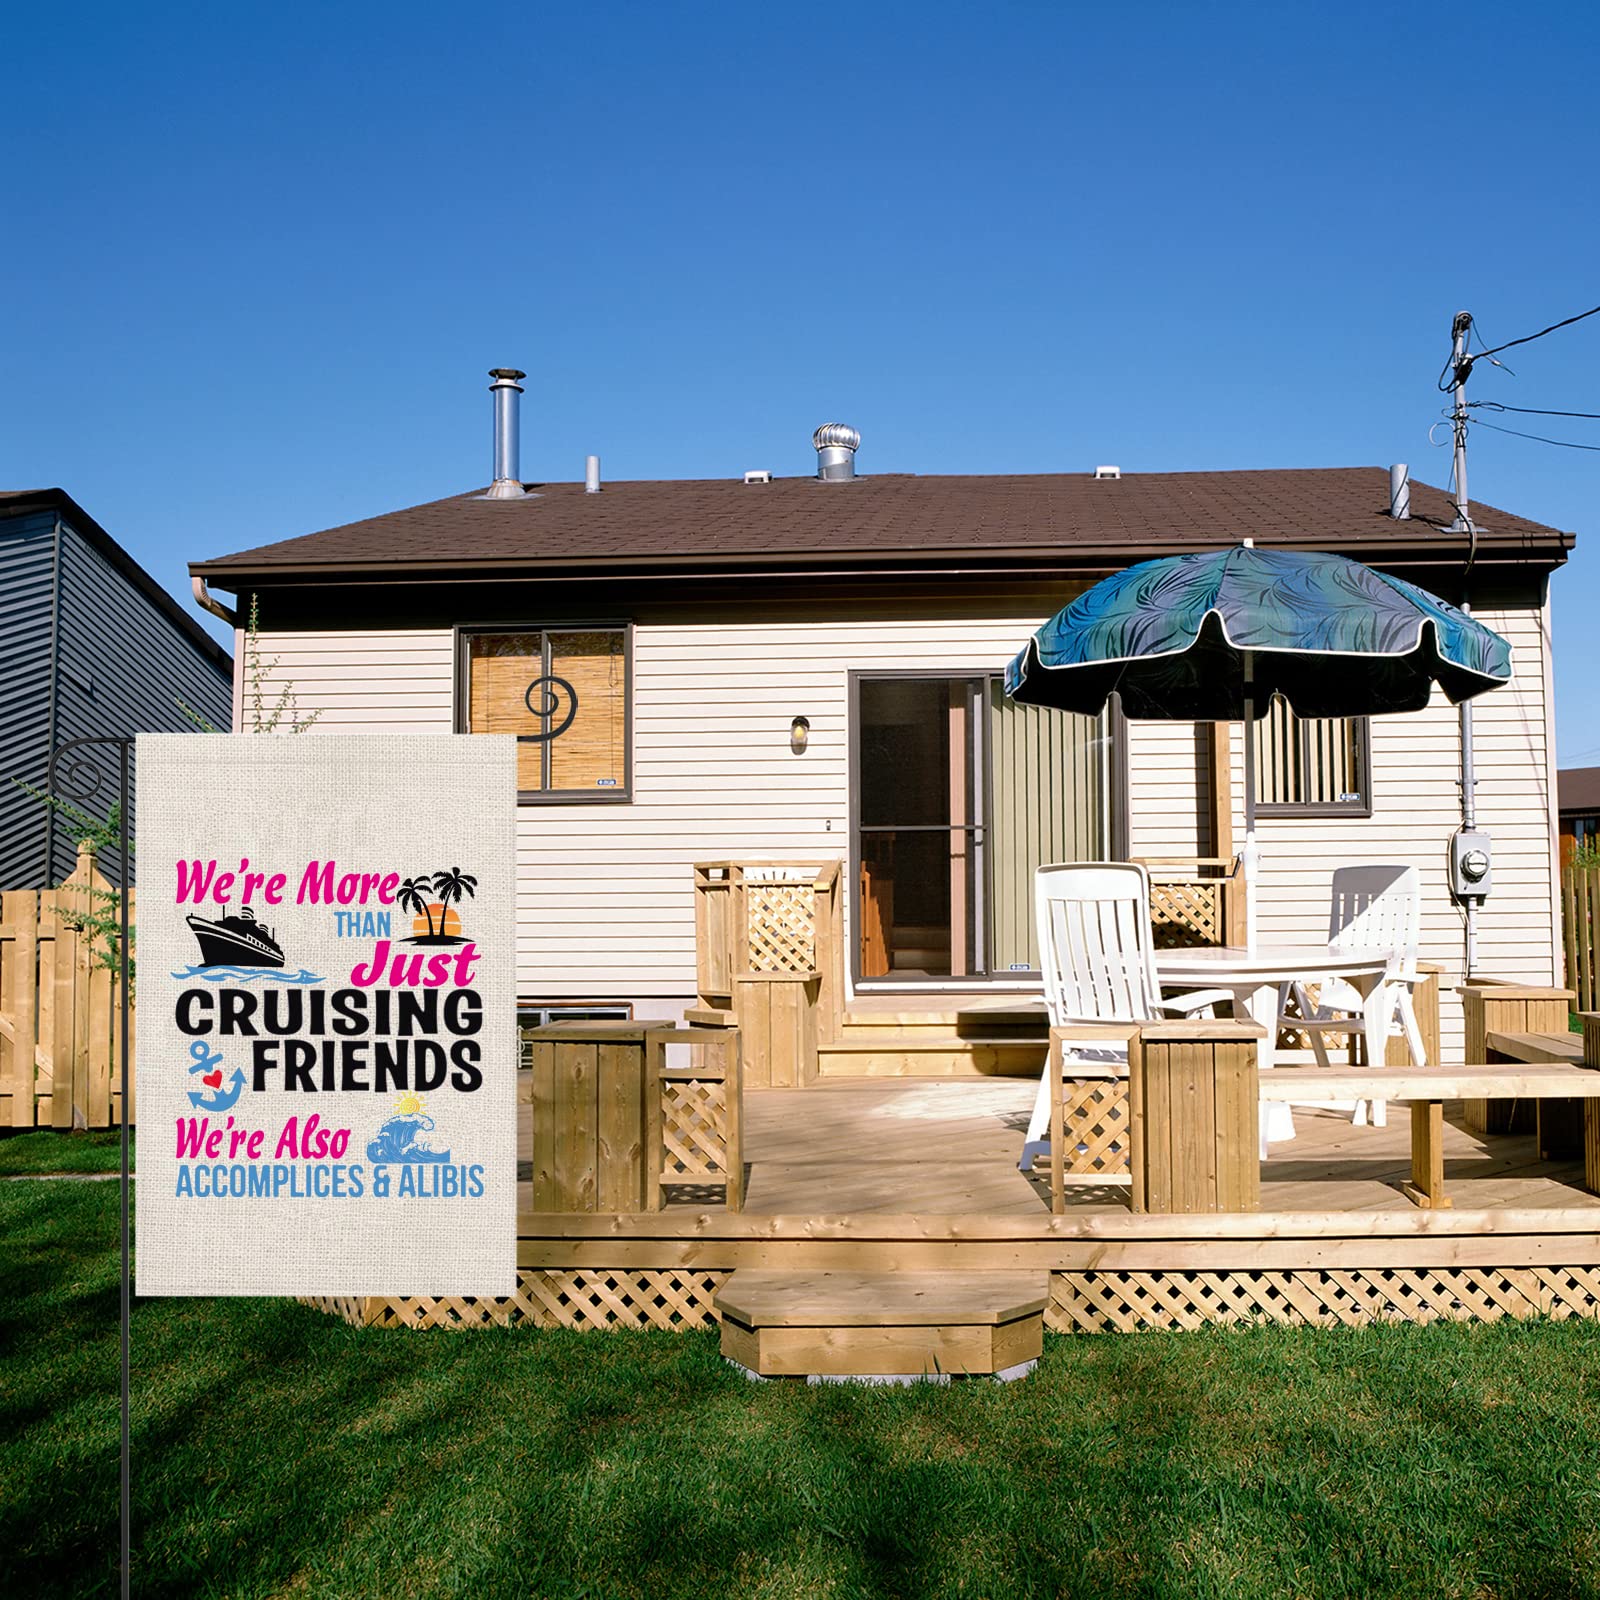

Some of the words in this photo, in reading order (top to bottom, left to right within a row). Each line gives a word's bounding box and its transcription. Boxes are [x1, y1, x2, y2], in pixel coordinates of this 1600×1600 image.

[175, 857, 287, 905] We're
[296, 860, 400, 905] More
[333, 911, 391, 938] THAN
[350, 940, 482, 987] Just
[175, 988, 483, 1036] CRUISING
[252, 1039, 483, 1093] FRIENDS
[175, 1116, 265, 1159] We're
[274, 1113, 351, 1160] Also
[175, 1164, 364, 1198] ACCOMPLICES
[373, 1164, 391, 1198] &
[400, 1164, 485, 1198] ALIBIS
